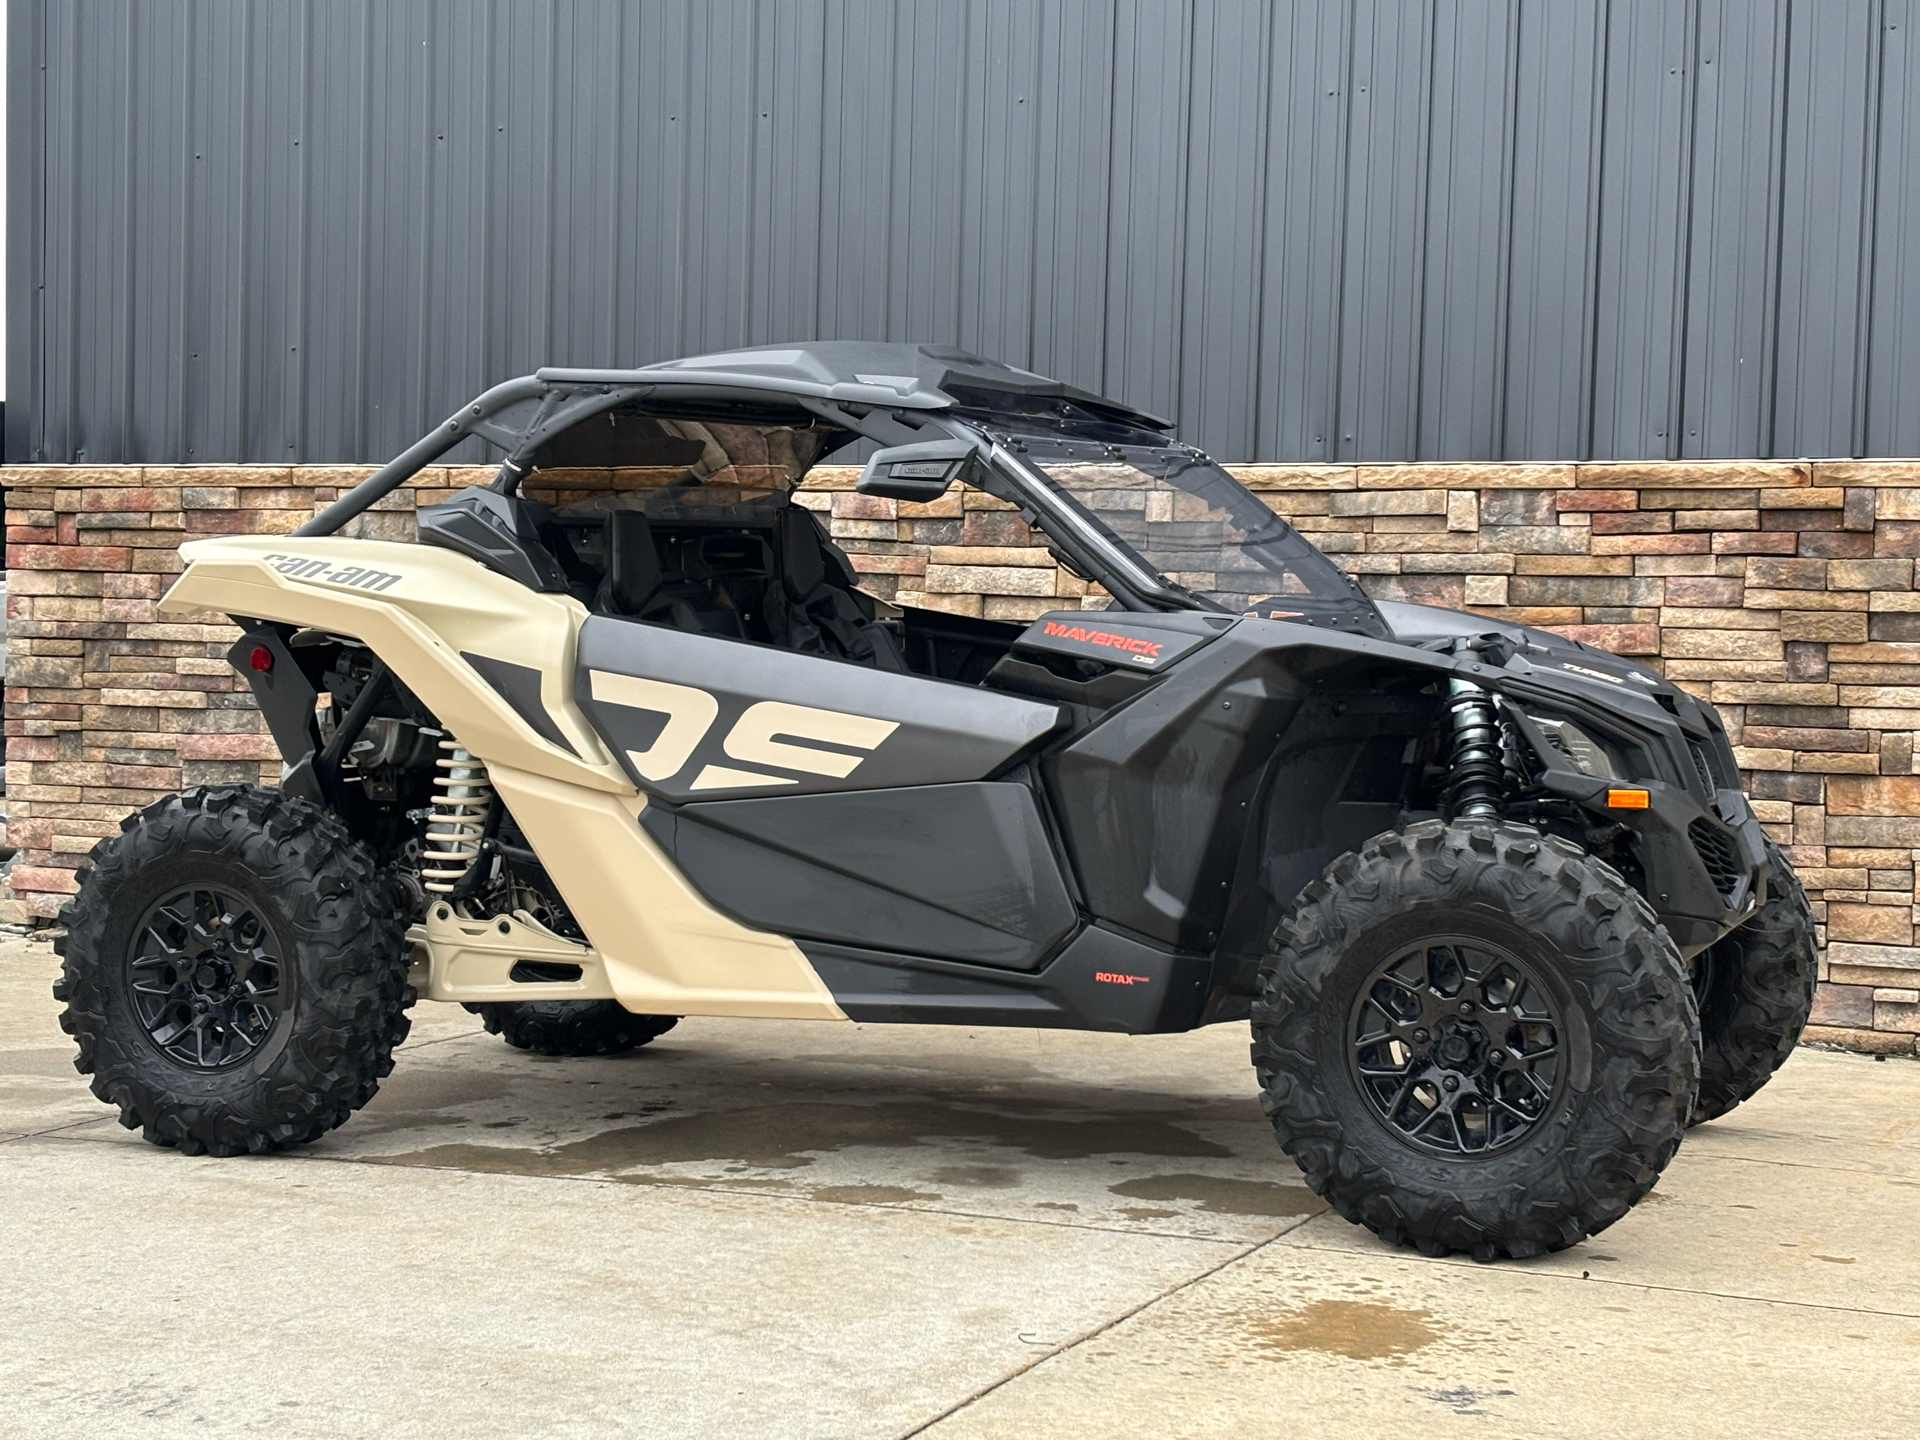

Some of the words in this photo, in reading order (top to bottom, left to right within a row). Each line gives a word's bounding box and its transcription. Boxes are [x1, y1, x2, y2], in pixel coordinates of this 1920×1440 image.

[263, 553, 403, 592] can-am
[1043, 621, 1163, 656] MAVERICK
[1132, 654, 1157, 664] DS
[1562, 662, 1624, 683] TURBO
[1095, 971, 1133, 985] ROTAX
